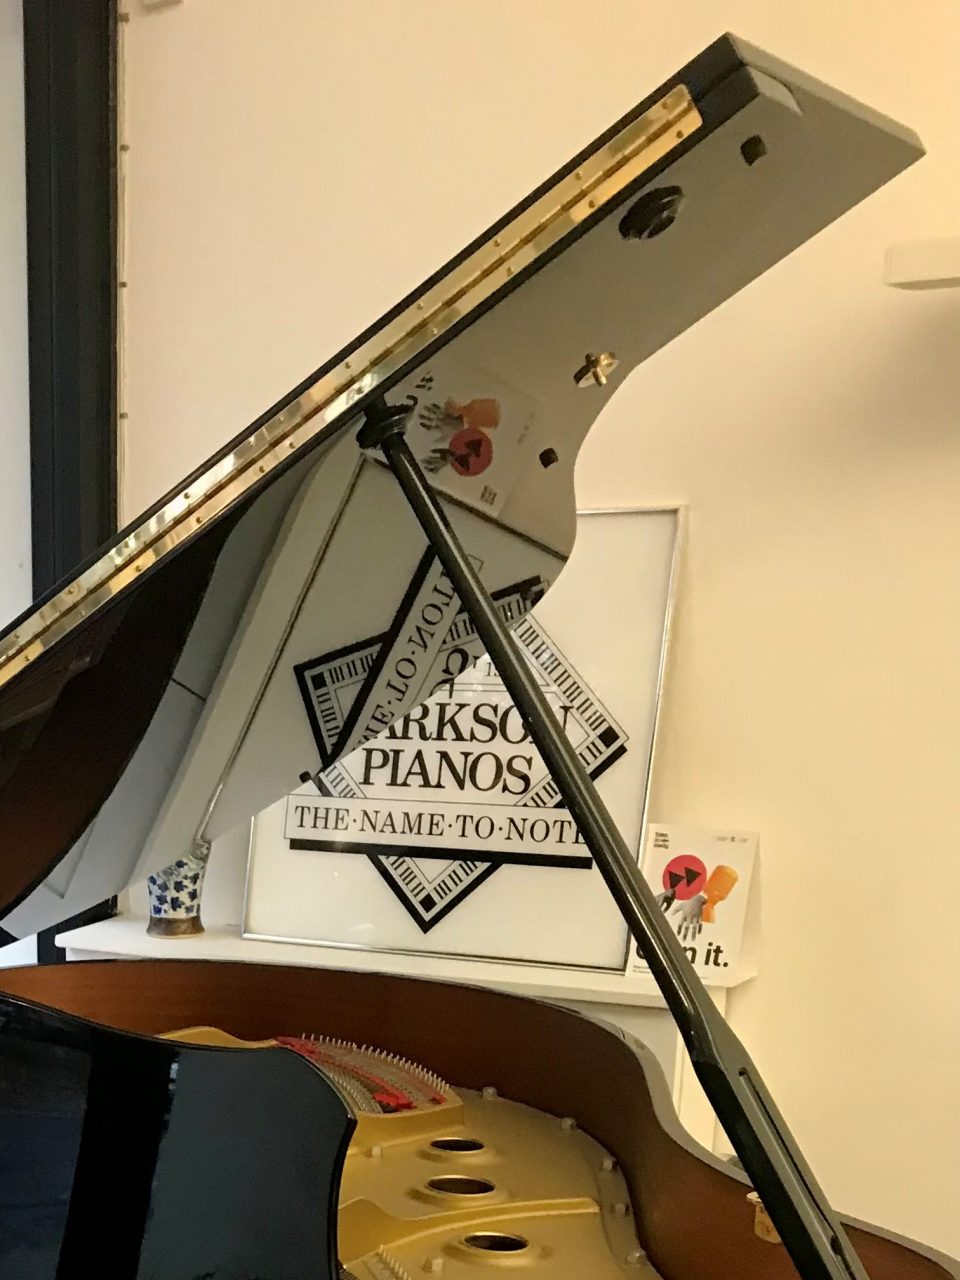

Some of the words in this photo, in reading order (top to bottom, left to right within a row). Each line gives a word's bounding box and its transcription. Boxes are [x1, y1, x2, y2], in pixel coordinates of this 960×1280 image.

[376, 702, 574, 745] RKSO
[358, 747, 533, 795] PIANOS
[704, 941, 729, 968] it.
